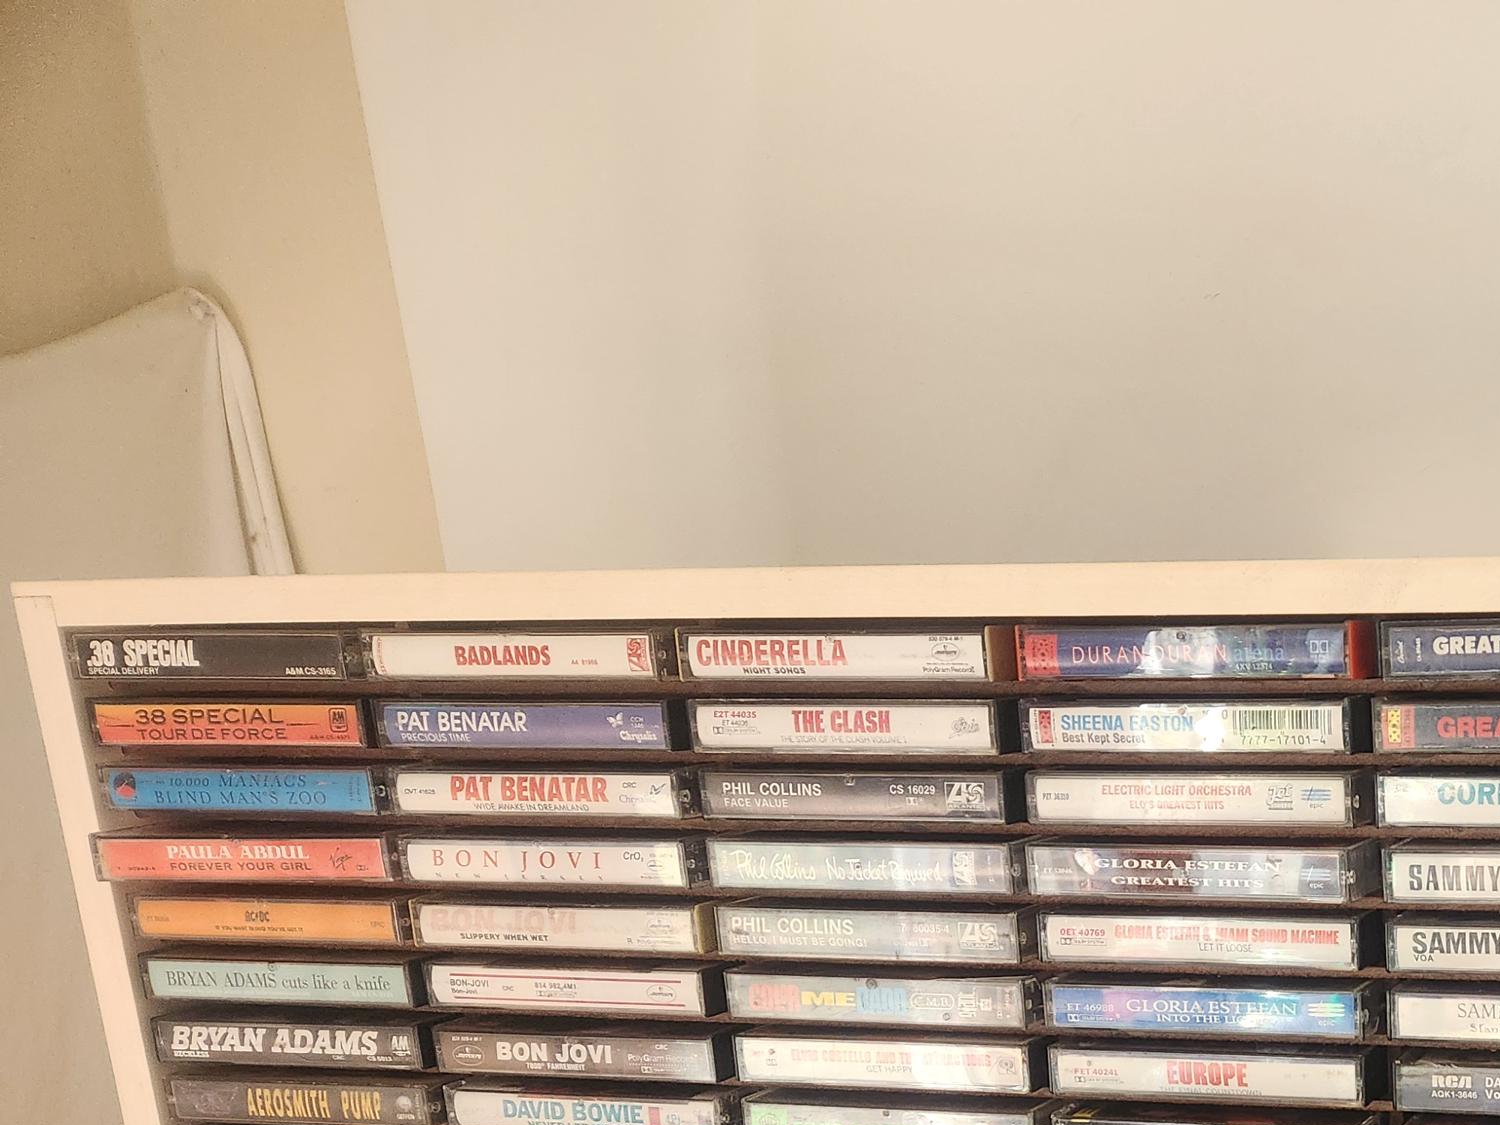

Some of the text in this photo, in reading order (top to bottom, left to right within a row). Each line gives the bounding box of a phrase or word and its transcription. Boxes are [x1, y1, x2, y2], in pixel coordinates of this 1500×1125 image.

[87, 639, 200, 667] .38 SPECIAL
[454, 645, 551, 667] BADLANDS
[696, 640, 848, 667] CINDERELLA
[88, 667, 159, 676] SPECIAL DELIVERY
[743, 667, 806, 675] NIGHT SONGS
[135, 708, 284, 725] 38 SPECIAL
[397, 711, 527, 733] PAT BENATAR
[791, 709, 891, 733] THE CLASH
[136, 727, 288, 741] TOUR DE FORCE
[400, 733, 471, 743] PRECIOUS TIME
[722, 782, 822, 797] PHIL COLLINS
[724, 798, 788, 807] FACE VALUE
[169, 861, 313, 873] FOREVER YOUR GIRL
[1413, 954, 1434, 962] VOA
[282, 975, 391, 992] cuts like a knife
[171, 1026, 378, 1056] BRYAN ADAMS
[496, 1041, 613, 1065] BON JOVI
[1167, 1060, 1249, 1087] EUROPE
[246, 1088, 381, 1120] AEROSMITH PUMP
[502, 1100, 645, 1123] DAVID BOWIE
